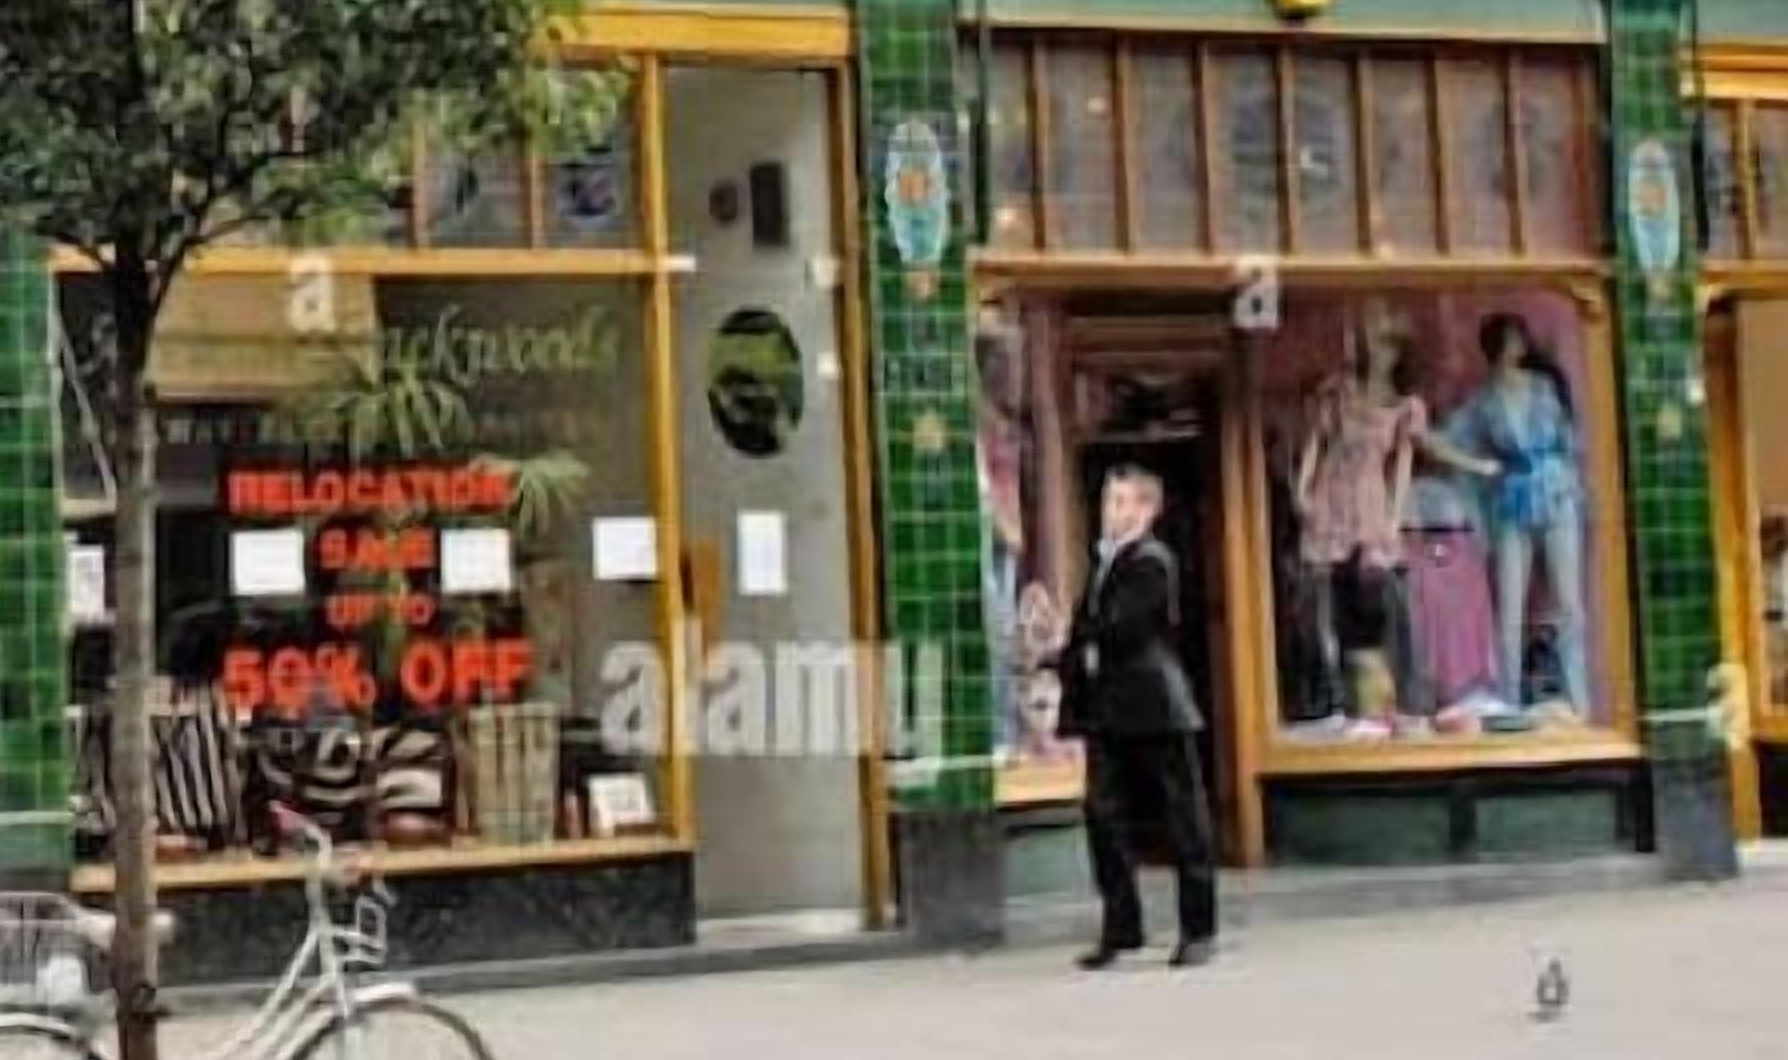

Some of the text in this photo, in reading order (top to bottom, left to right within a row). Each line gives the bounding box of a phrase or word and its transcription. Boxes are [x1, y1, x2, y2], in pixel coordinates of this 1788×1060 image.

[227, 470, 513, 516] RELOCATION
[319, 528, 435, 569] SALE
[222, 637, 536, 712] 50% OFF
